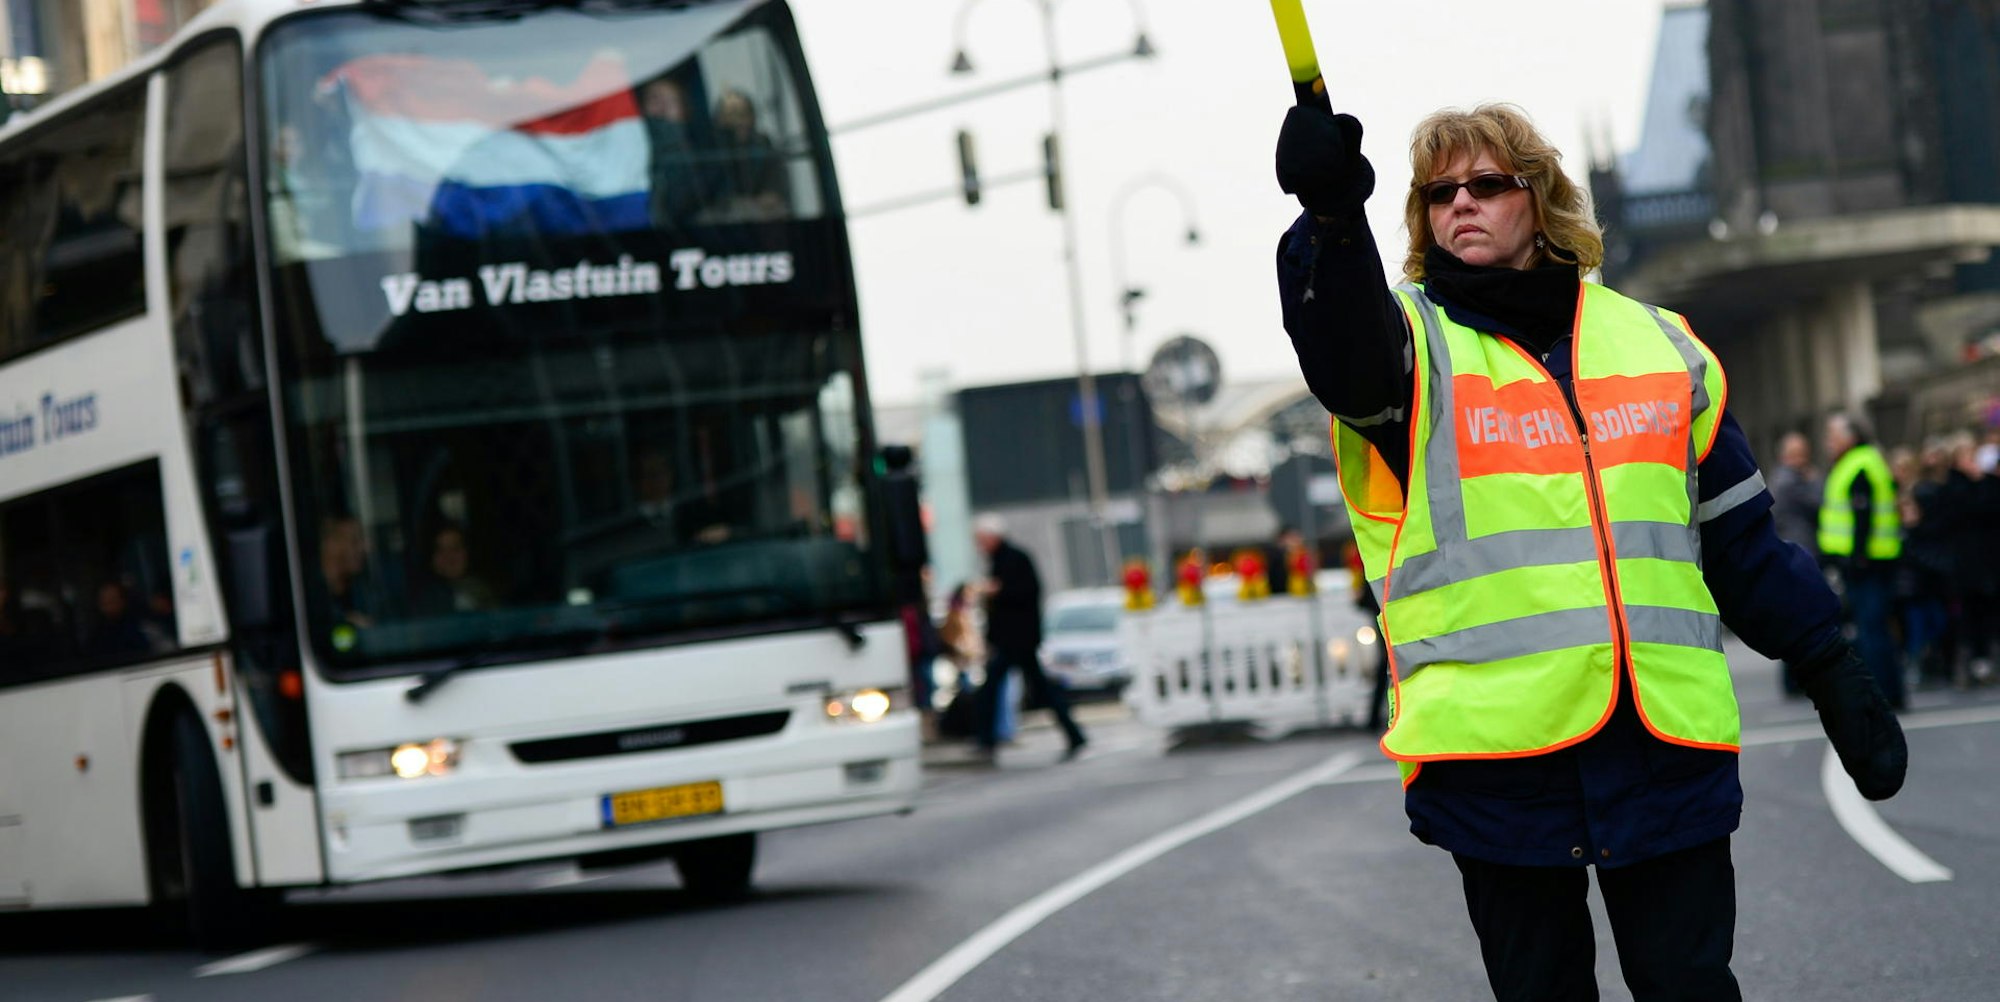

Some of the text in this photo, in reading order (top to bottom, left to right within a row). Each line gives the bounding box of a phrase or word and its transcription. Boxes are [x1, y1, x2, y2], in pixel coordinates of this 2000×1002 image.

[381, 247, 795, 316] Van Vlastuin Tours
[41, 393, 97, 445] Tours
